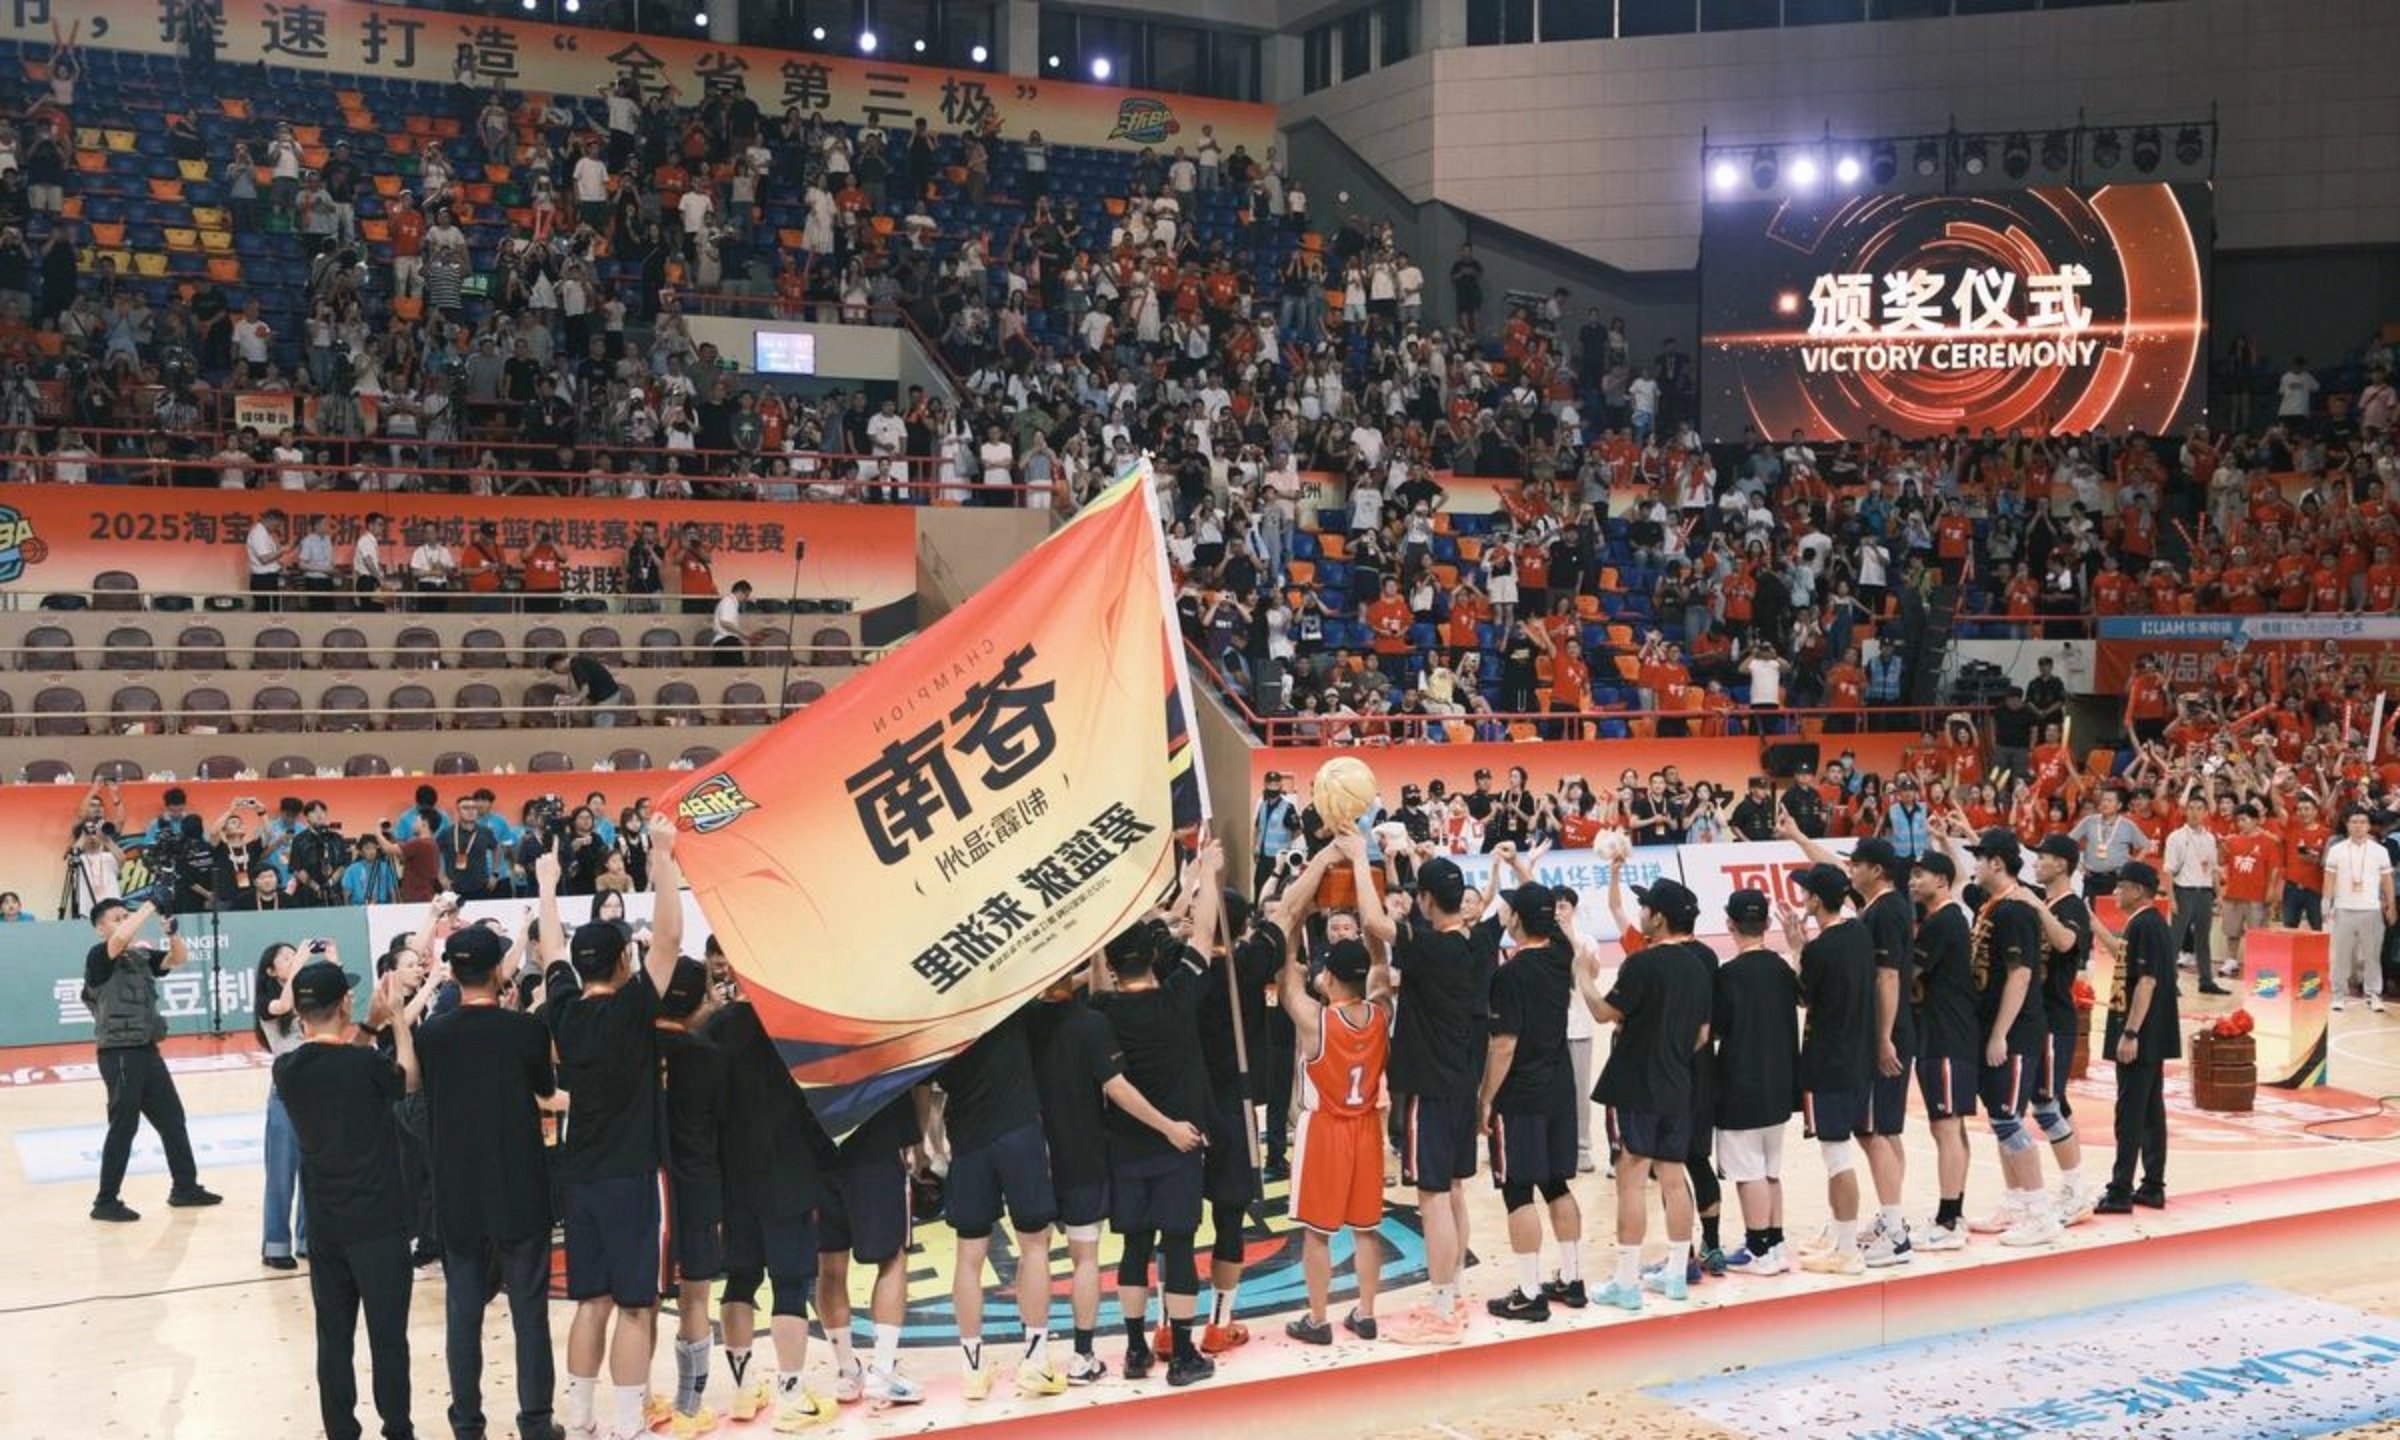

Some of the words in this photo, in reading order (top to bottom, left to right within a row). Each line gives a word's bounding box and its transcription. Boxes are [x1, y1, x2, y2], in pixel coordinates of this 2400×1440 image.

[1808, 264, 2092, 337] 颁奖仪式
[1801, 344, 1924, 374] VICTORY
[1931, 340, 2097, 371] CEREMONY
[160, 934, 230, 951] DNGRI
[1345, 1064, 1366, 1107] 1
